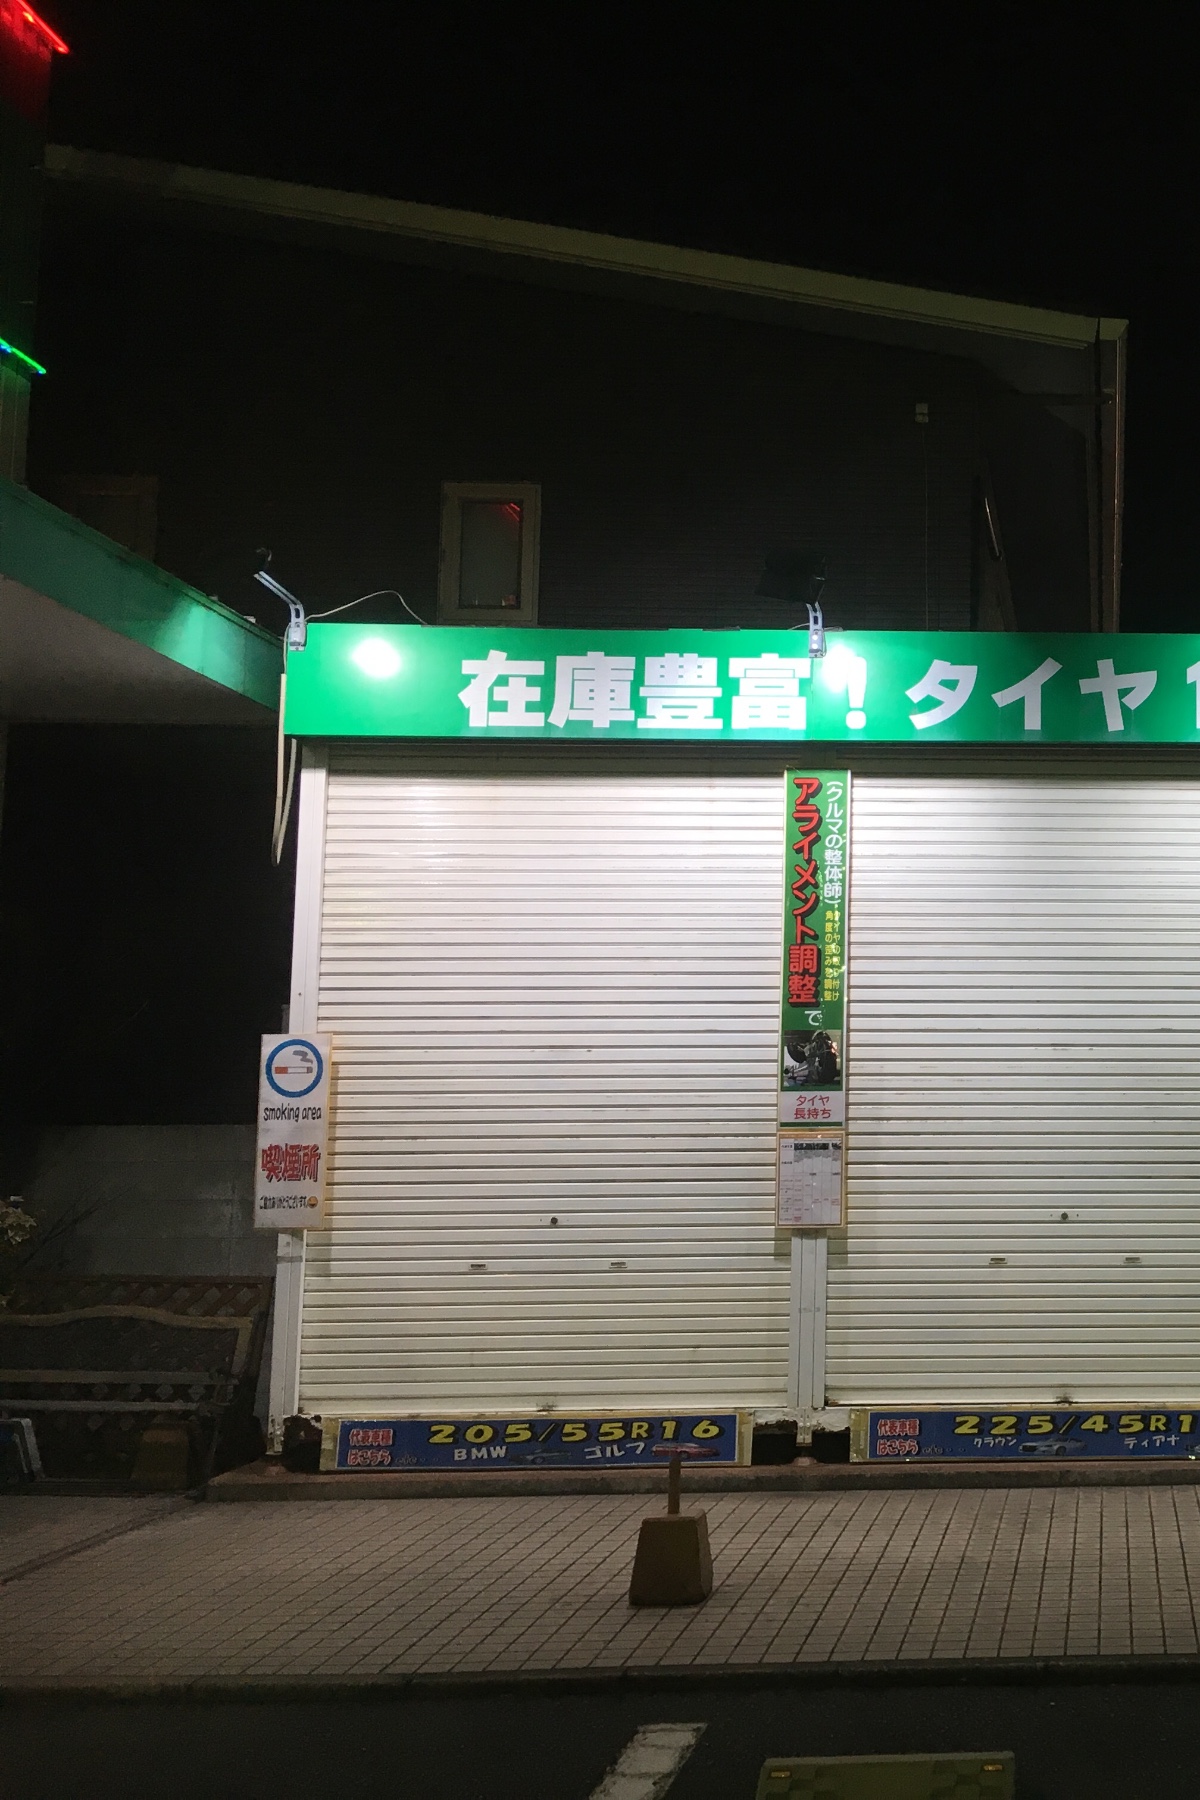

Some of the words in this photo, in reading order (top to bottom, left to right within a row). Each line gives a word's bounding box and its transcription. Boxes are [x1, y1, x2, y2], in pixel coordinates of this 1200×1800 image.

[796, 1095, 830, 1107] タイヤ
[263, 1103, 299, 1122] smoking
[301, 1105, 322, 1120] area
[794, 1107, 832, 1120] 長持ち
[261, 1142, 321, 1182] 喫煙所
[428, 1418, 720, 1444] 205/55R16
[877, 1418, 919, 1436] 代表車種
[350, 1428, 393, 1446] 代表車種
[973, 1436, 1017, 1448] クラウン
[1124, 1434, 1180, 1449] ティアナ
[453, 1445, 508, 1461] BMW
[584, 1441, 646, 1460] ゴルフ
[876, 1439, 918, 1455] はこちら
[347, 1449, 391, 1465] はこちら
